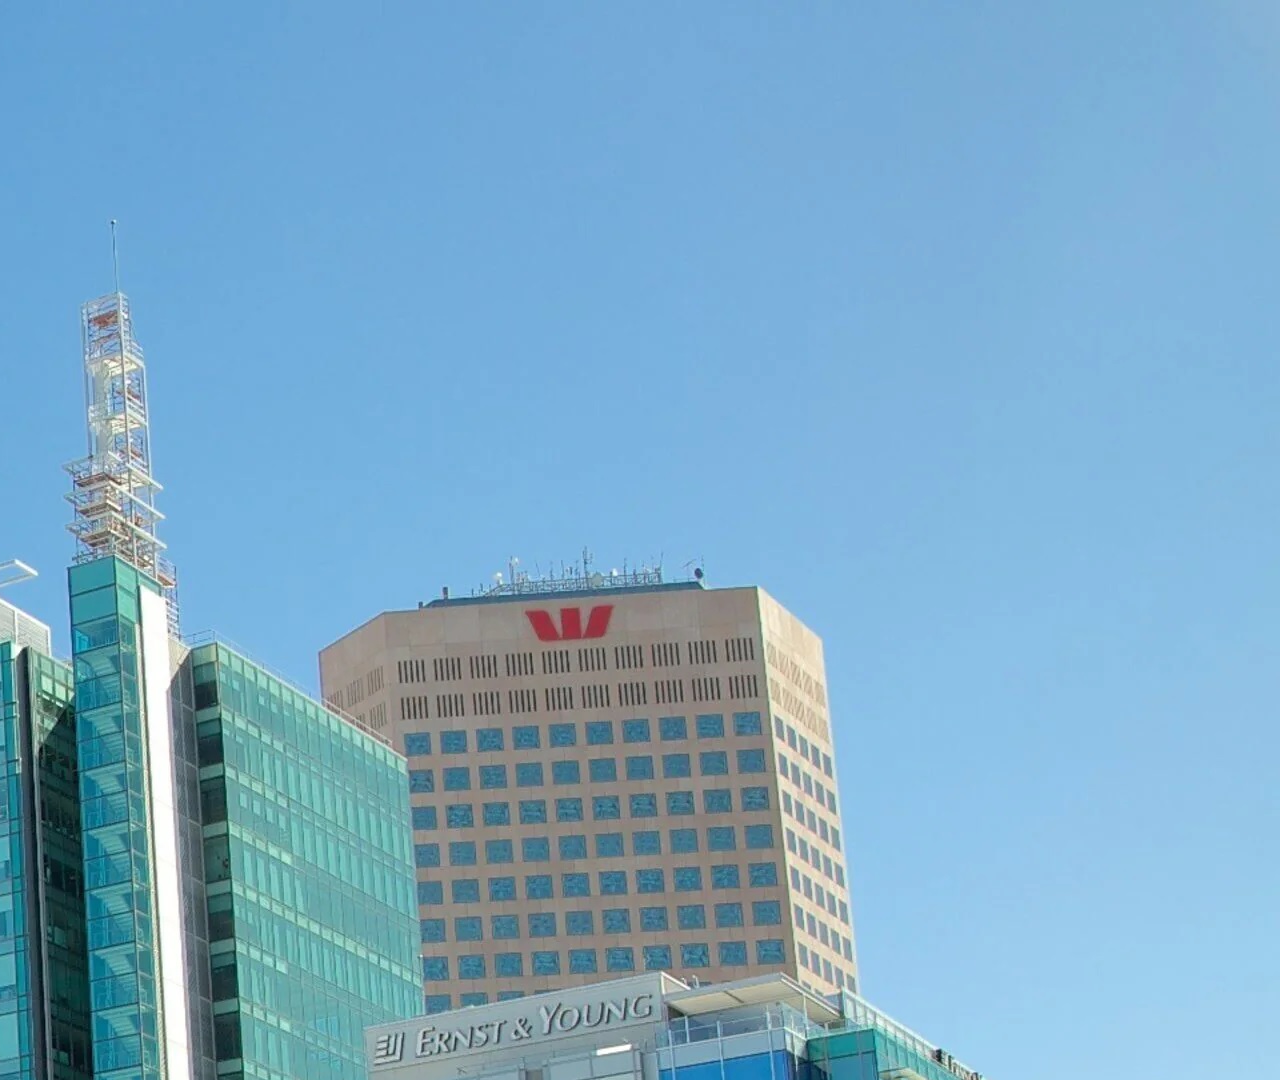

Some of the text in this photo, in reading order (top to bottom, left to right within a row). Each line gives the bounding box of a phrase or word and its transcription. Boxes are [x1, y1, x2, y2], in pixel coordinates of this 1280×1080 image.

[415, 1019, 507, 1059] ERNST
[510, 1017, 533, 1041] &
[539, 993, 653, 1036] YOUNG
